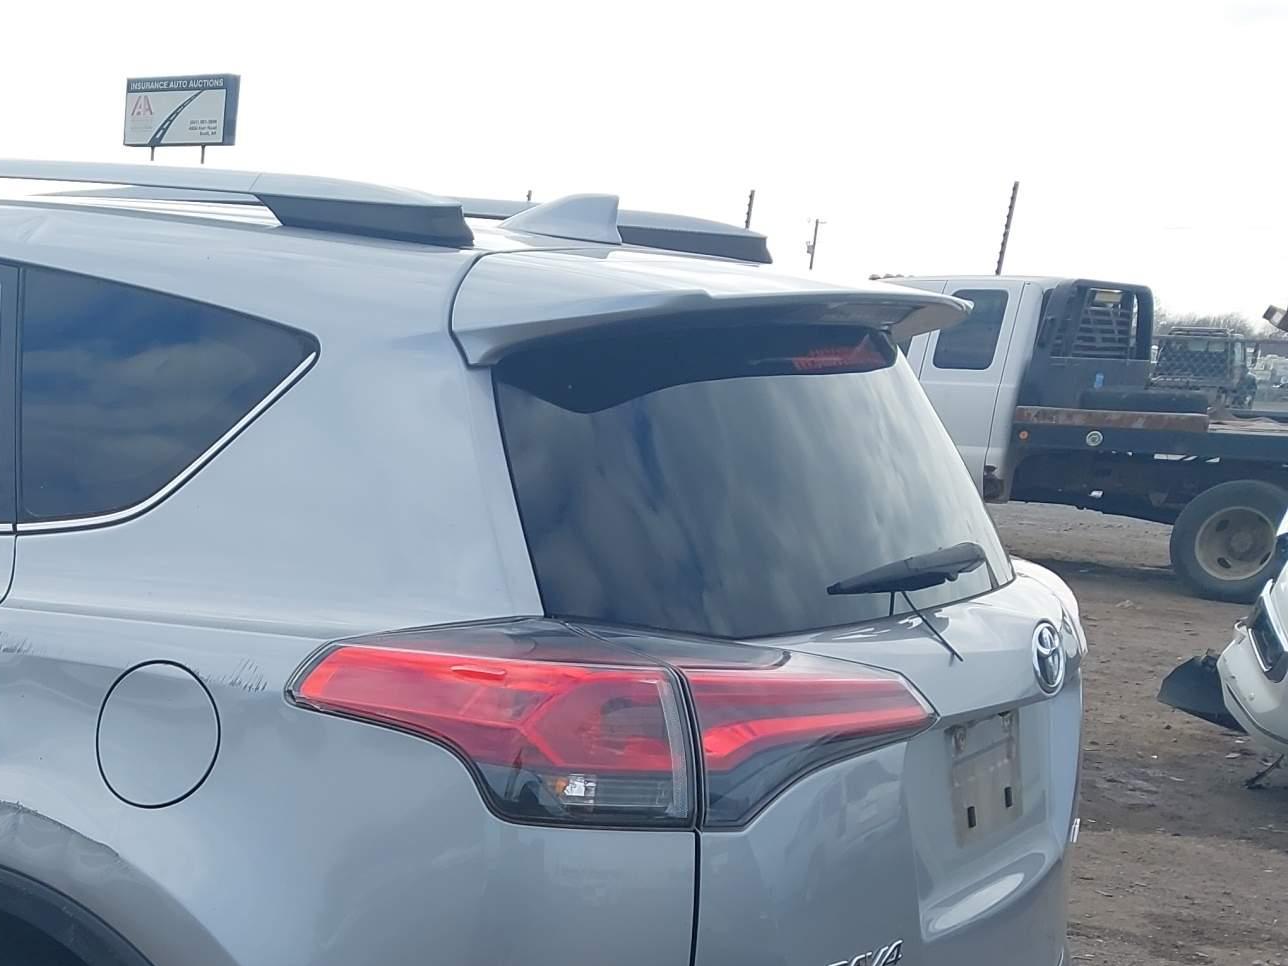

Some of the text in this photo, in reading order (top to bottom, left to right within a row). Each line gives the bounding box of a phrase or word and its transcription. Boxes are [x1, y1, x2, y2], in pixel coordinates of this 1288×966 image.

[130, 78, 224, 90] INSURANCE AUTO AUCTIONS
